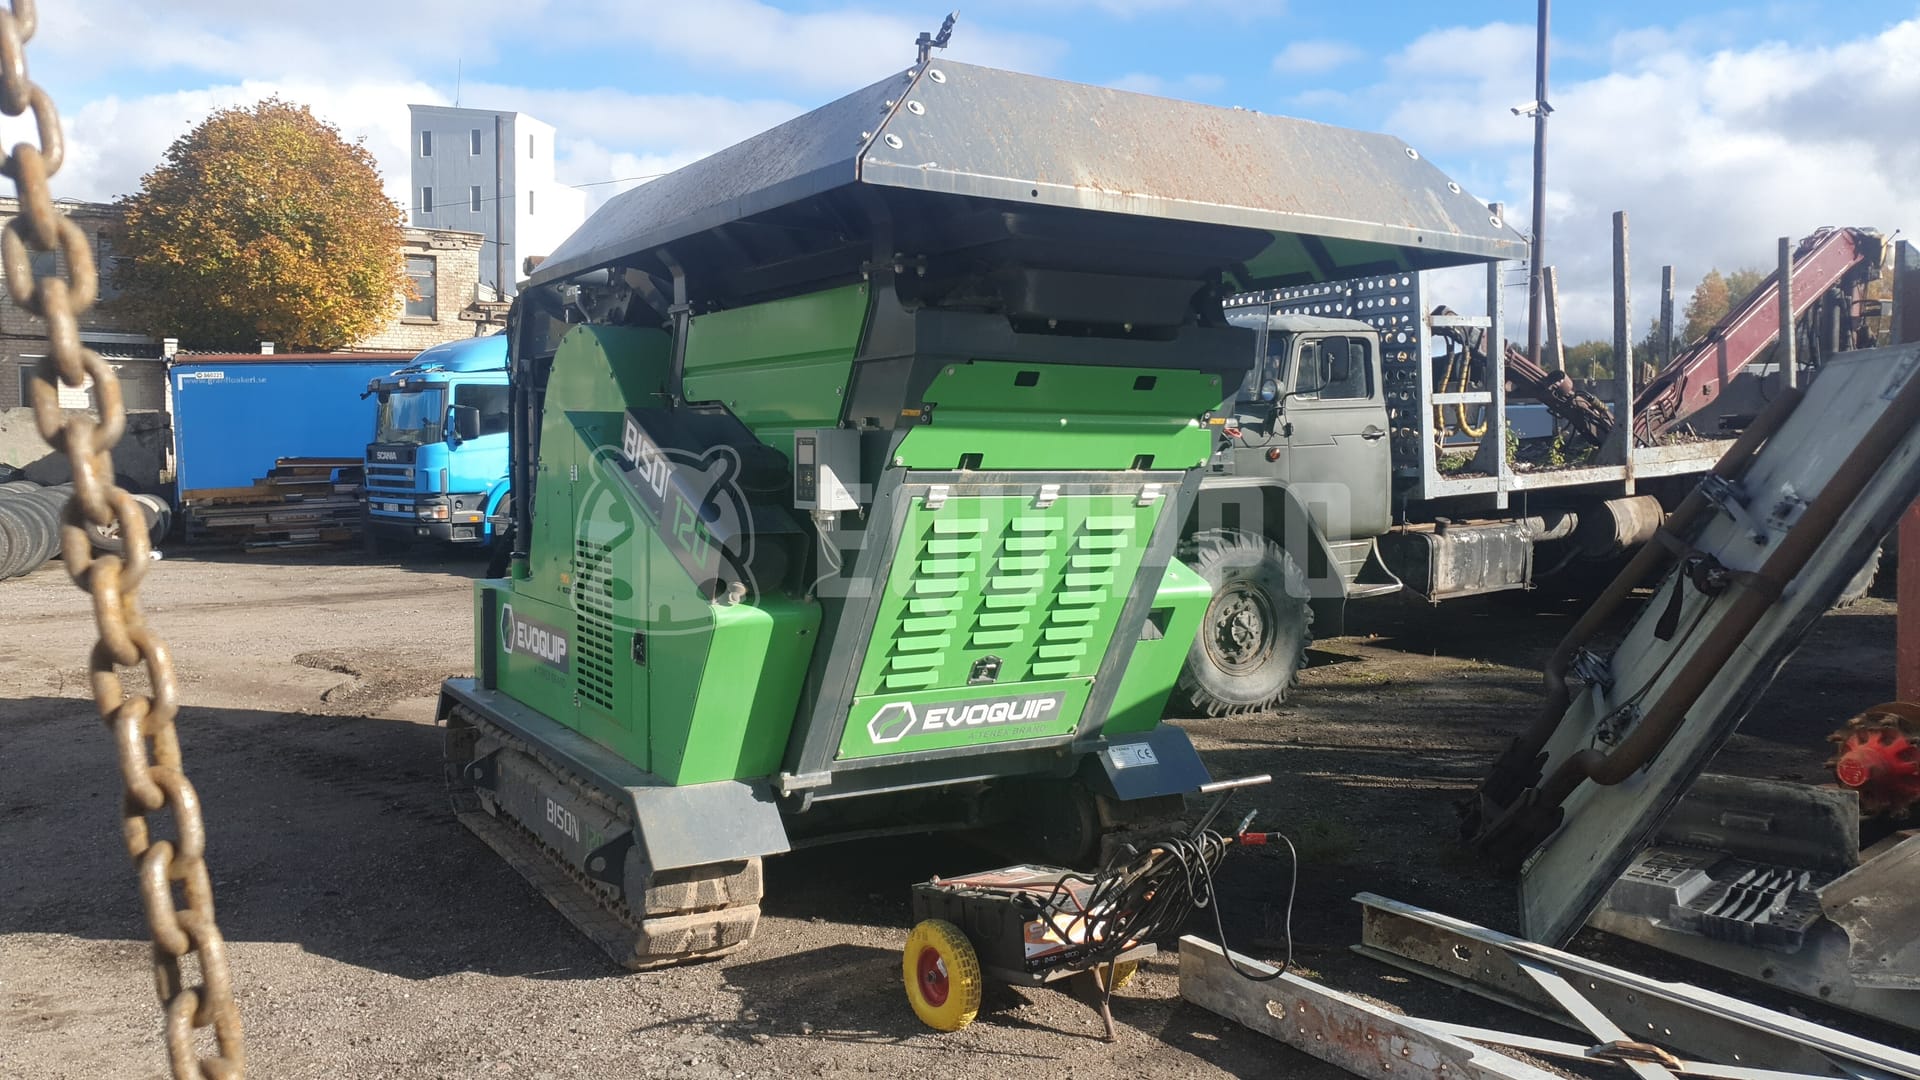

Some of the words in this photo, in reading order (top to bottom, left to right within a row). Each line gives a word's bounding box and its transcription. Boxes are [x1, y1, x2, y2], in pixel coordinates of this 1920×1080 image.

[377, 451, 397, 460] SCANIA
[672, 495, 710, 570] 120
[517, 621, 566, 664] EVOQUIP
[922, 698, 1056, 730] EVOQUIP
[546, 798, 580, 842] BISON
